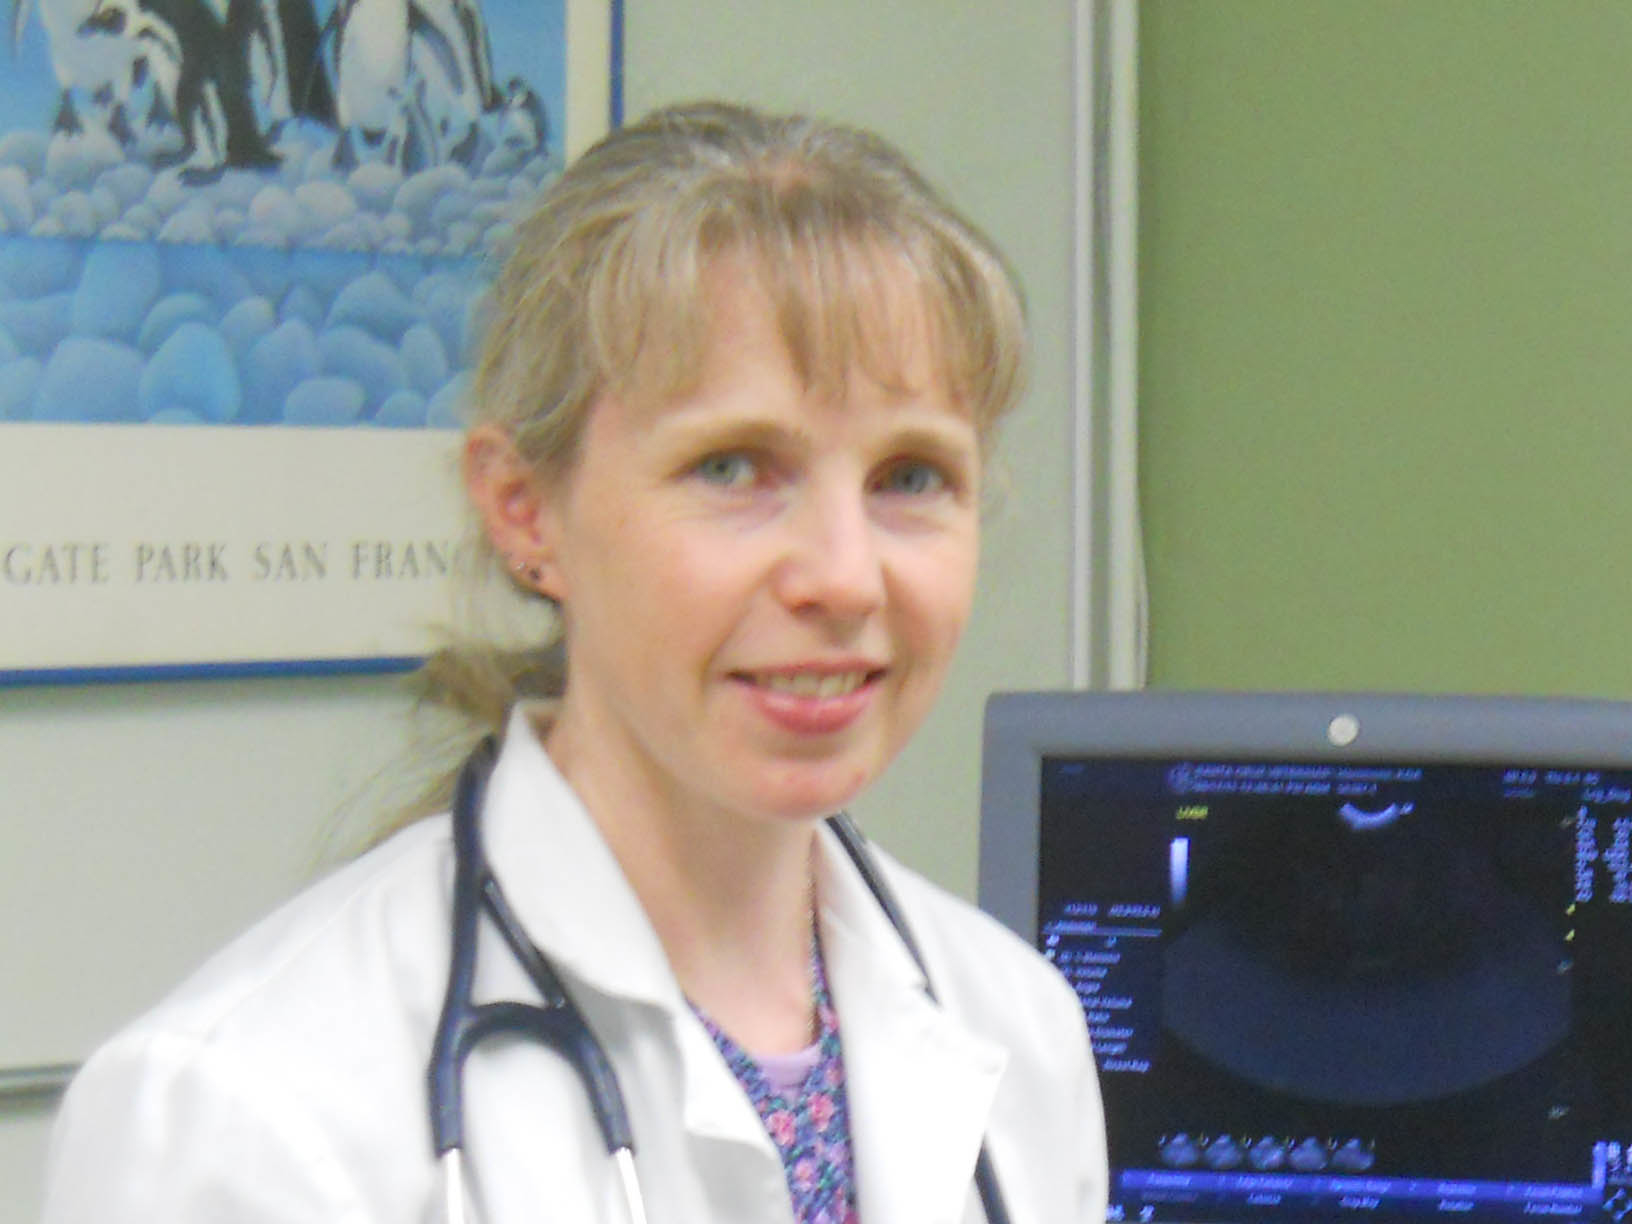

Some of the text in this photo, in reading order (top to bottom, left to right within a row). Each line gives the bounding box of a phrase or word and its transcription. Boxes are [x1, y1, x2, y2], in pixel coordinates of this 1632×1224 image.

[2, 539, 450, 584] GATE PARK SAN FRAN
